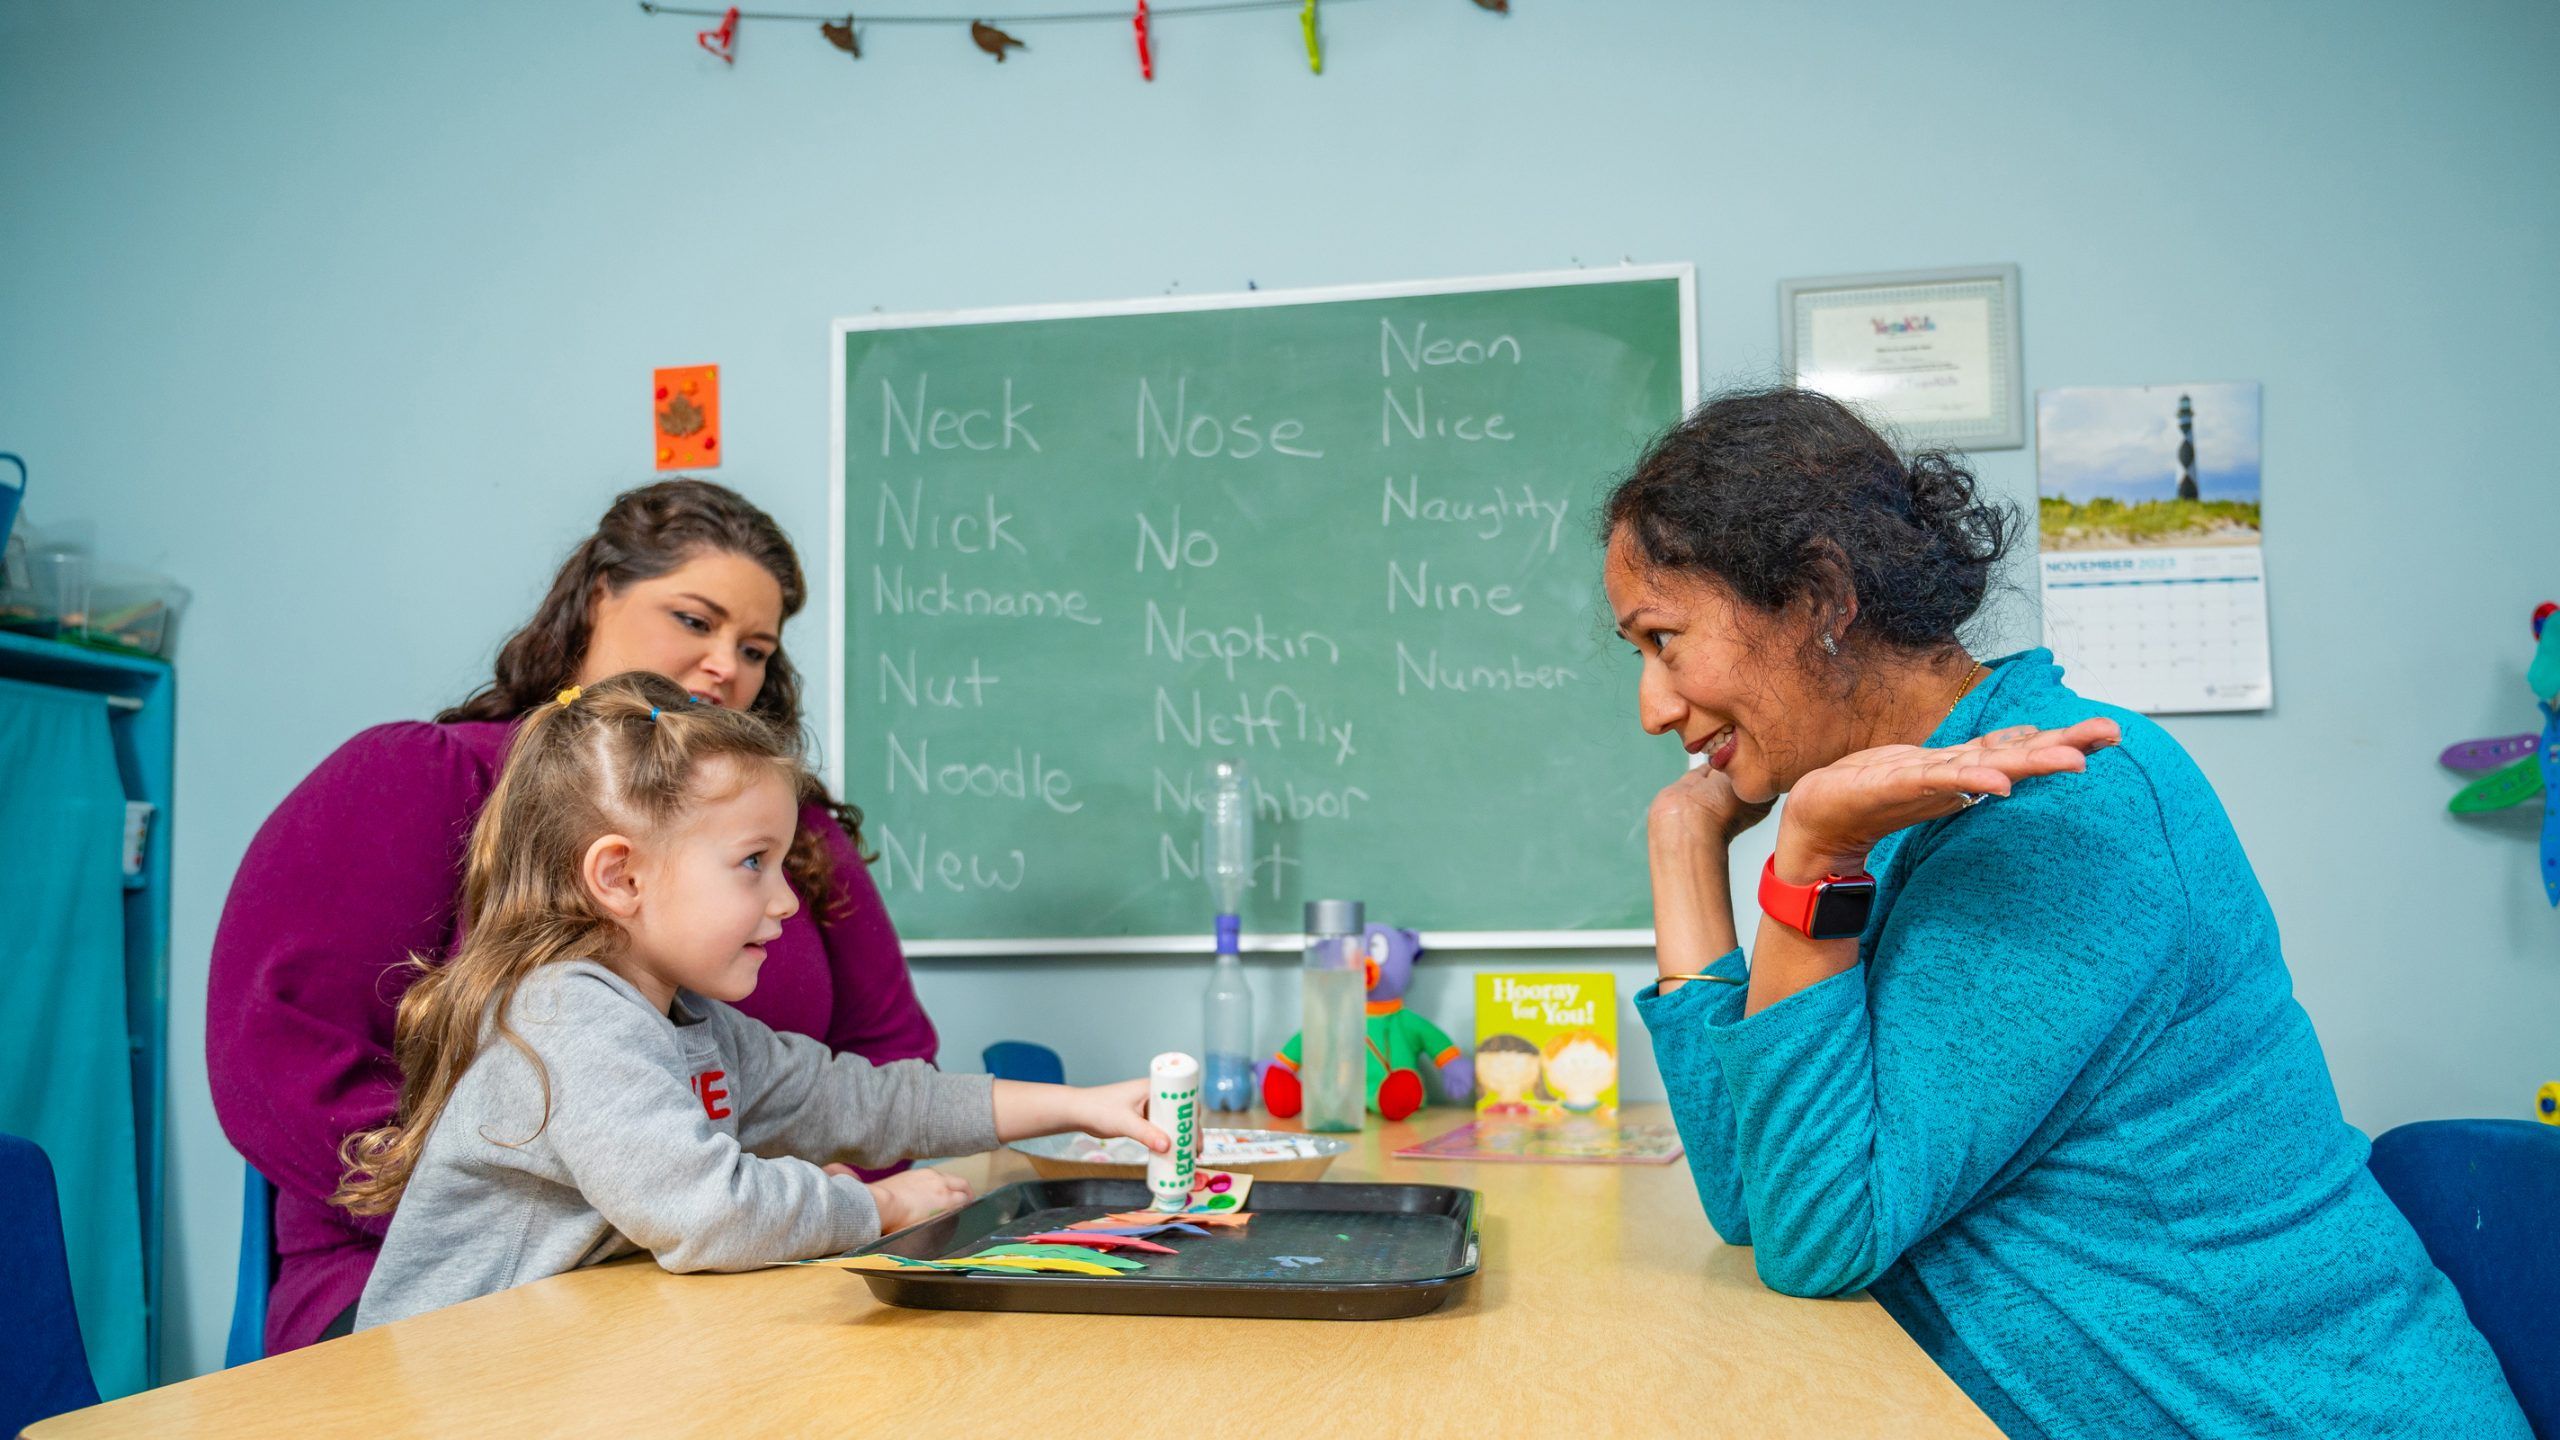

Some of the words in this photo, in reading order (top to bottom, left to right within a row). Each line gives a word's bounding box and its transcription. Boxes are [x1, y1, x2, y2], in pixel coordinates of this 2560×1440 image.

[1380, 317, 1521, 377] Neon
[880, 372, 1041, 457] Neck
[1136, 376, 1324, 459] Nose
[1382, 386, 1515, 446] Nice
[875, 476, 1026, 554] Nick
[1134, 503, 1220, 573] No
[1382, 474, 1568, 554] Naughty
[873, 564, 1101, 624] Nickname
[1387, 561, 1524, 615] Nine
[2046, 559, 2133, 573] NOVEMBER
[1145, 600, 1338, 681] Napkin
[1396, 641, 1578, 694] Number
[879, 650, 1000, 708] Nut
[1154, 686, 1355, 765] Netflix
[886, 731, 1083, 813] Noodle
[880, 823, 1025, 892] New
[1492, 978, 1580, 1007] Hooray
[1511, 1004, 1539, 1020] for
[1541, 1001, 1595, 1026] You!
[1176, 1101, 1194, 1176] green
